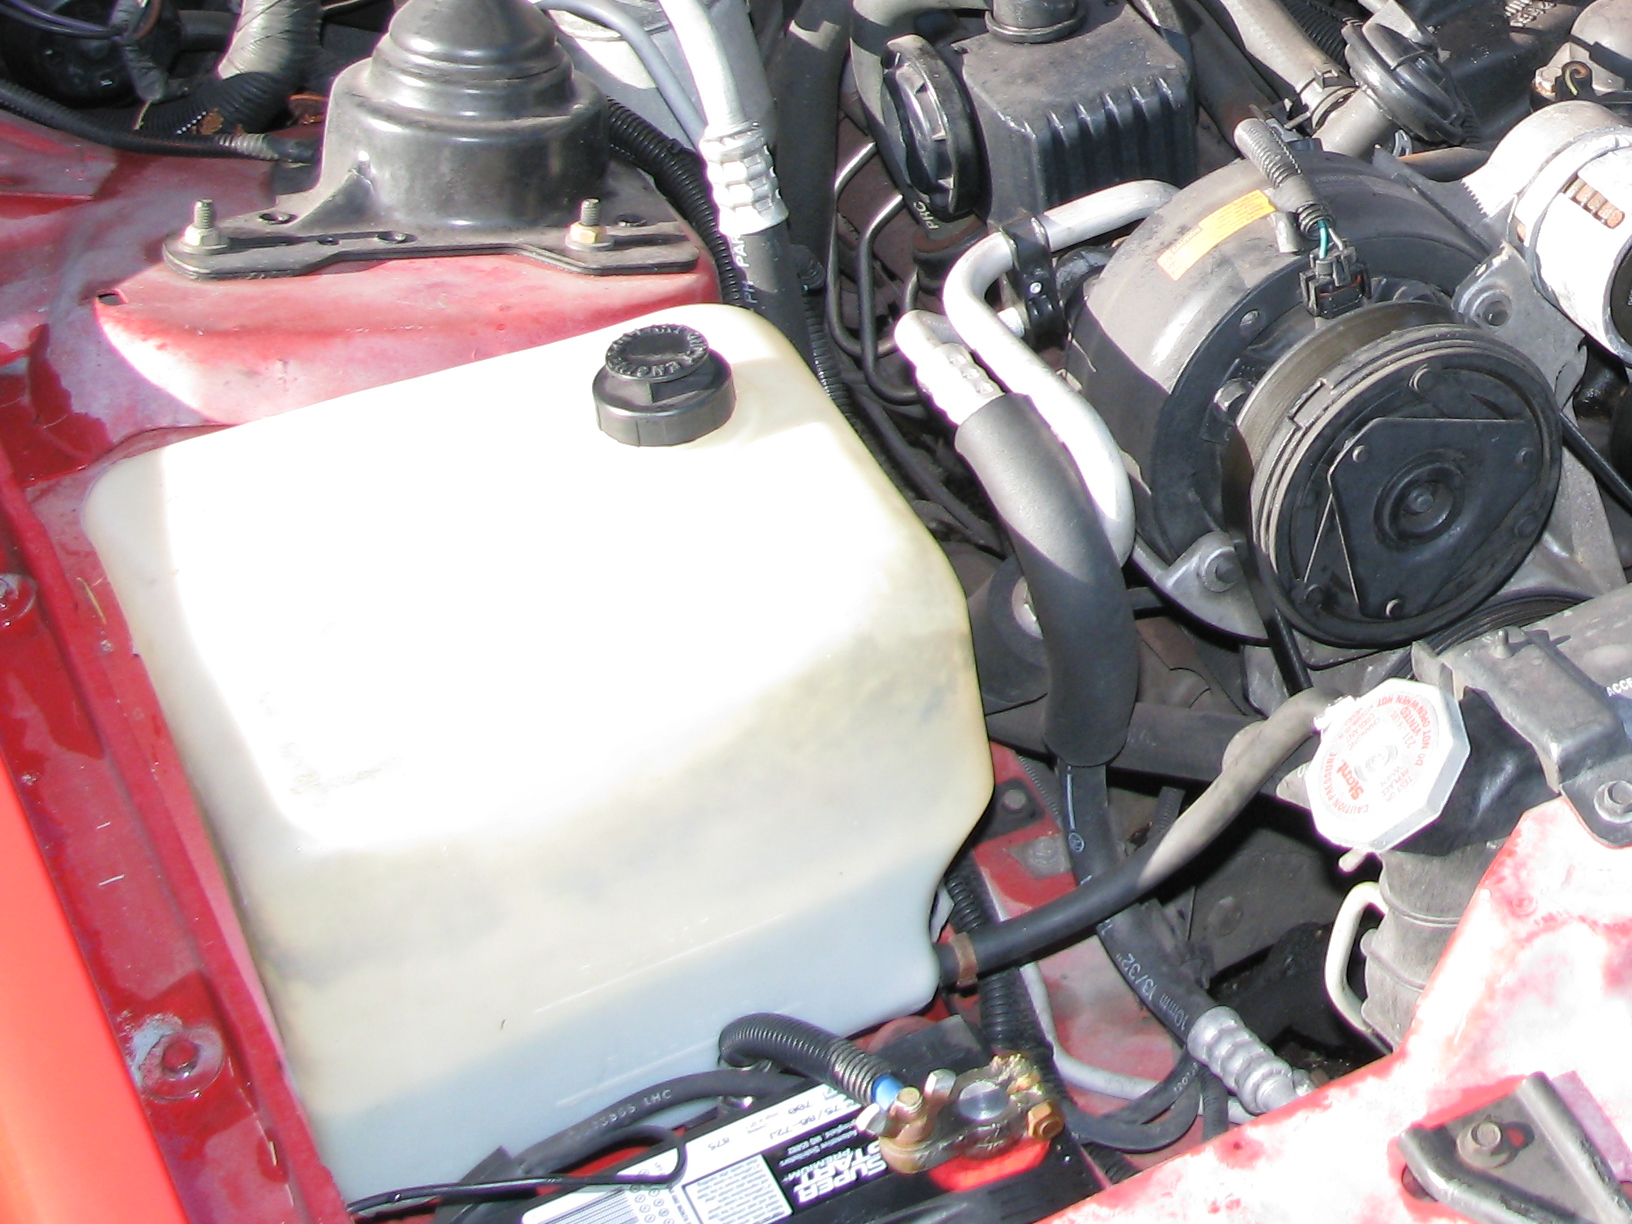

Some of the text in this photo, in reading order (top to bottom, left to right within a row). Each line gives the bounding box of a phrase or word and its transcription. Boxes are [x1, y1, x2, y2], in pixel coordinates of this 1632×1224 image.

[1377, 696, 1394, 707] HOT
[1395, 694, 1421, 711] WHEN
[1415, 707, 1431, 729] OPEN
[1400, 706, 1422, 736] VENTED
[1421, 729, 1432, 750] NOT
[1323, 752, 1369, 814] CAUTION PRESSURE
[1336, 761, 1364, 801] Stant
[1115, 951, 1157, 1001] 13/32"
[1160, 992, 1190, 1030] 10mm
[788, 1148, 852, 1181] PREMIUM
[794, 1154, 888, 1203] SUPER
[800, 1140, 880, 1184] START
